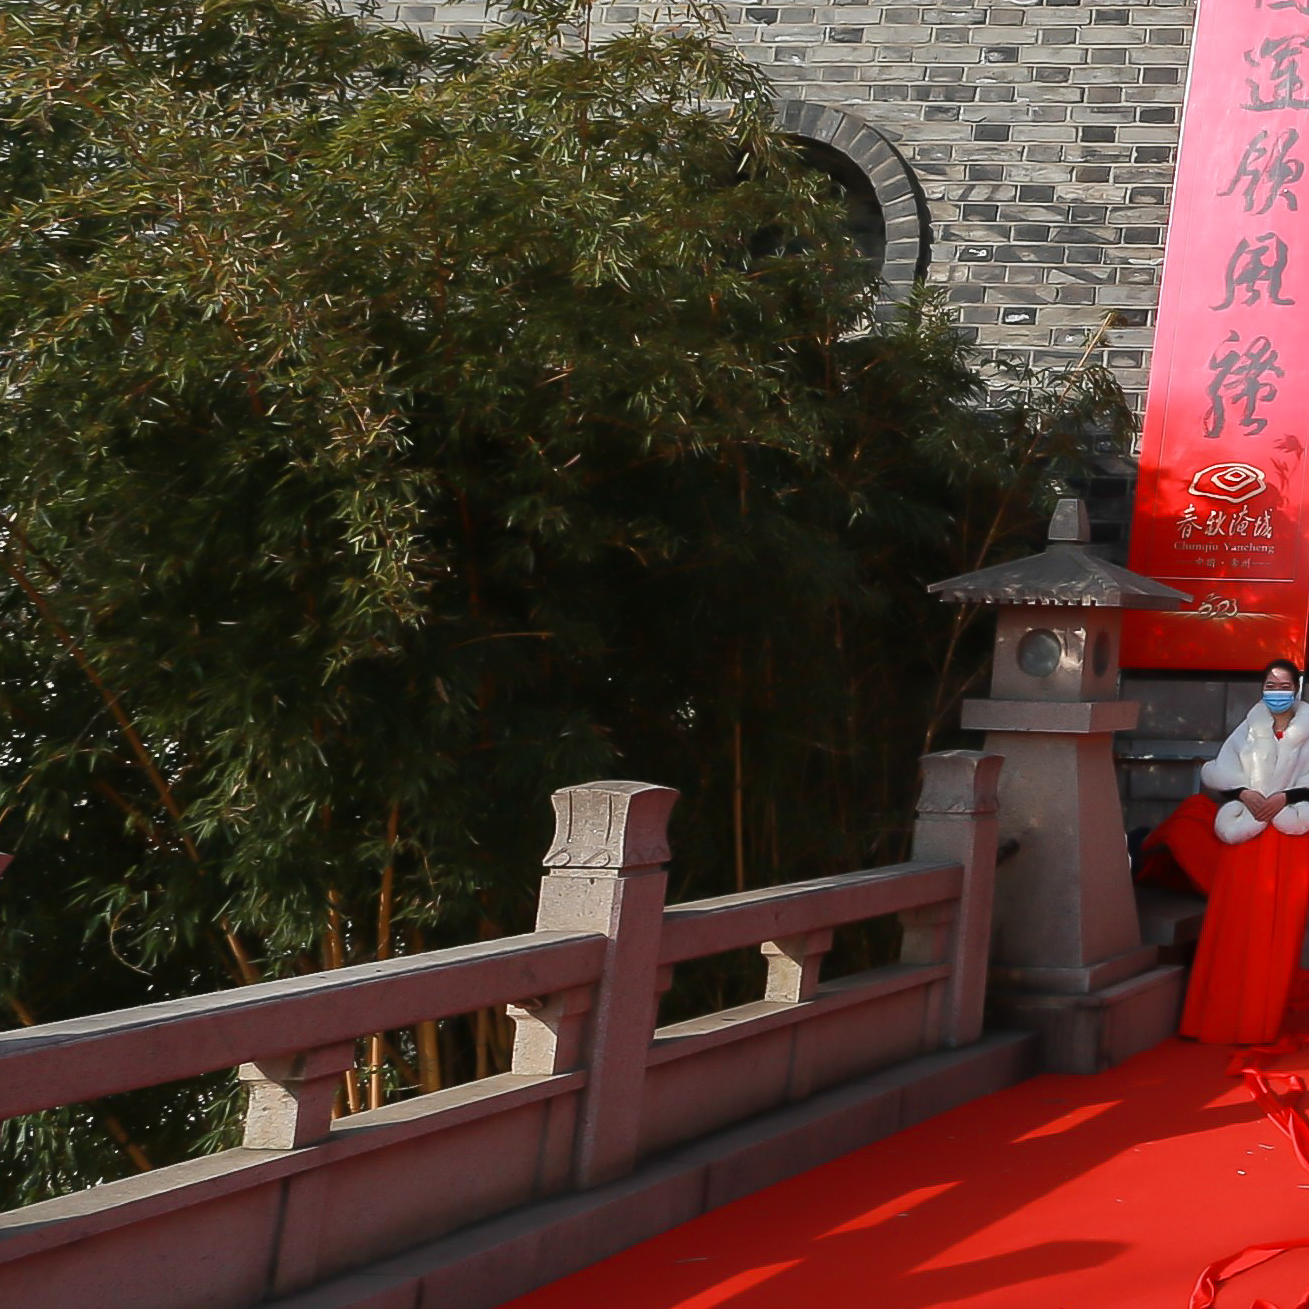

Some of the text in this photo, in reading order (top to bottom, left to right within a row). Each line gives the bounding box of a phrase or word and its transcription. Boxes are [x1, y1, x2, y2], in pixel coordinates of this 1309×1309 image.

[1176, 503, 1273, 539] 春秋淹城
[1174, 541, 1275, 554] Chunqiu Yancheng
